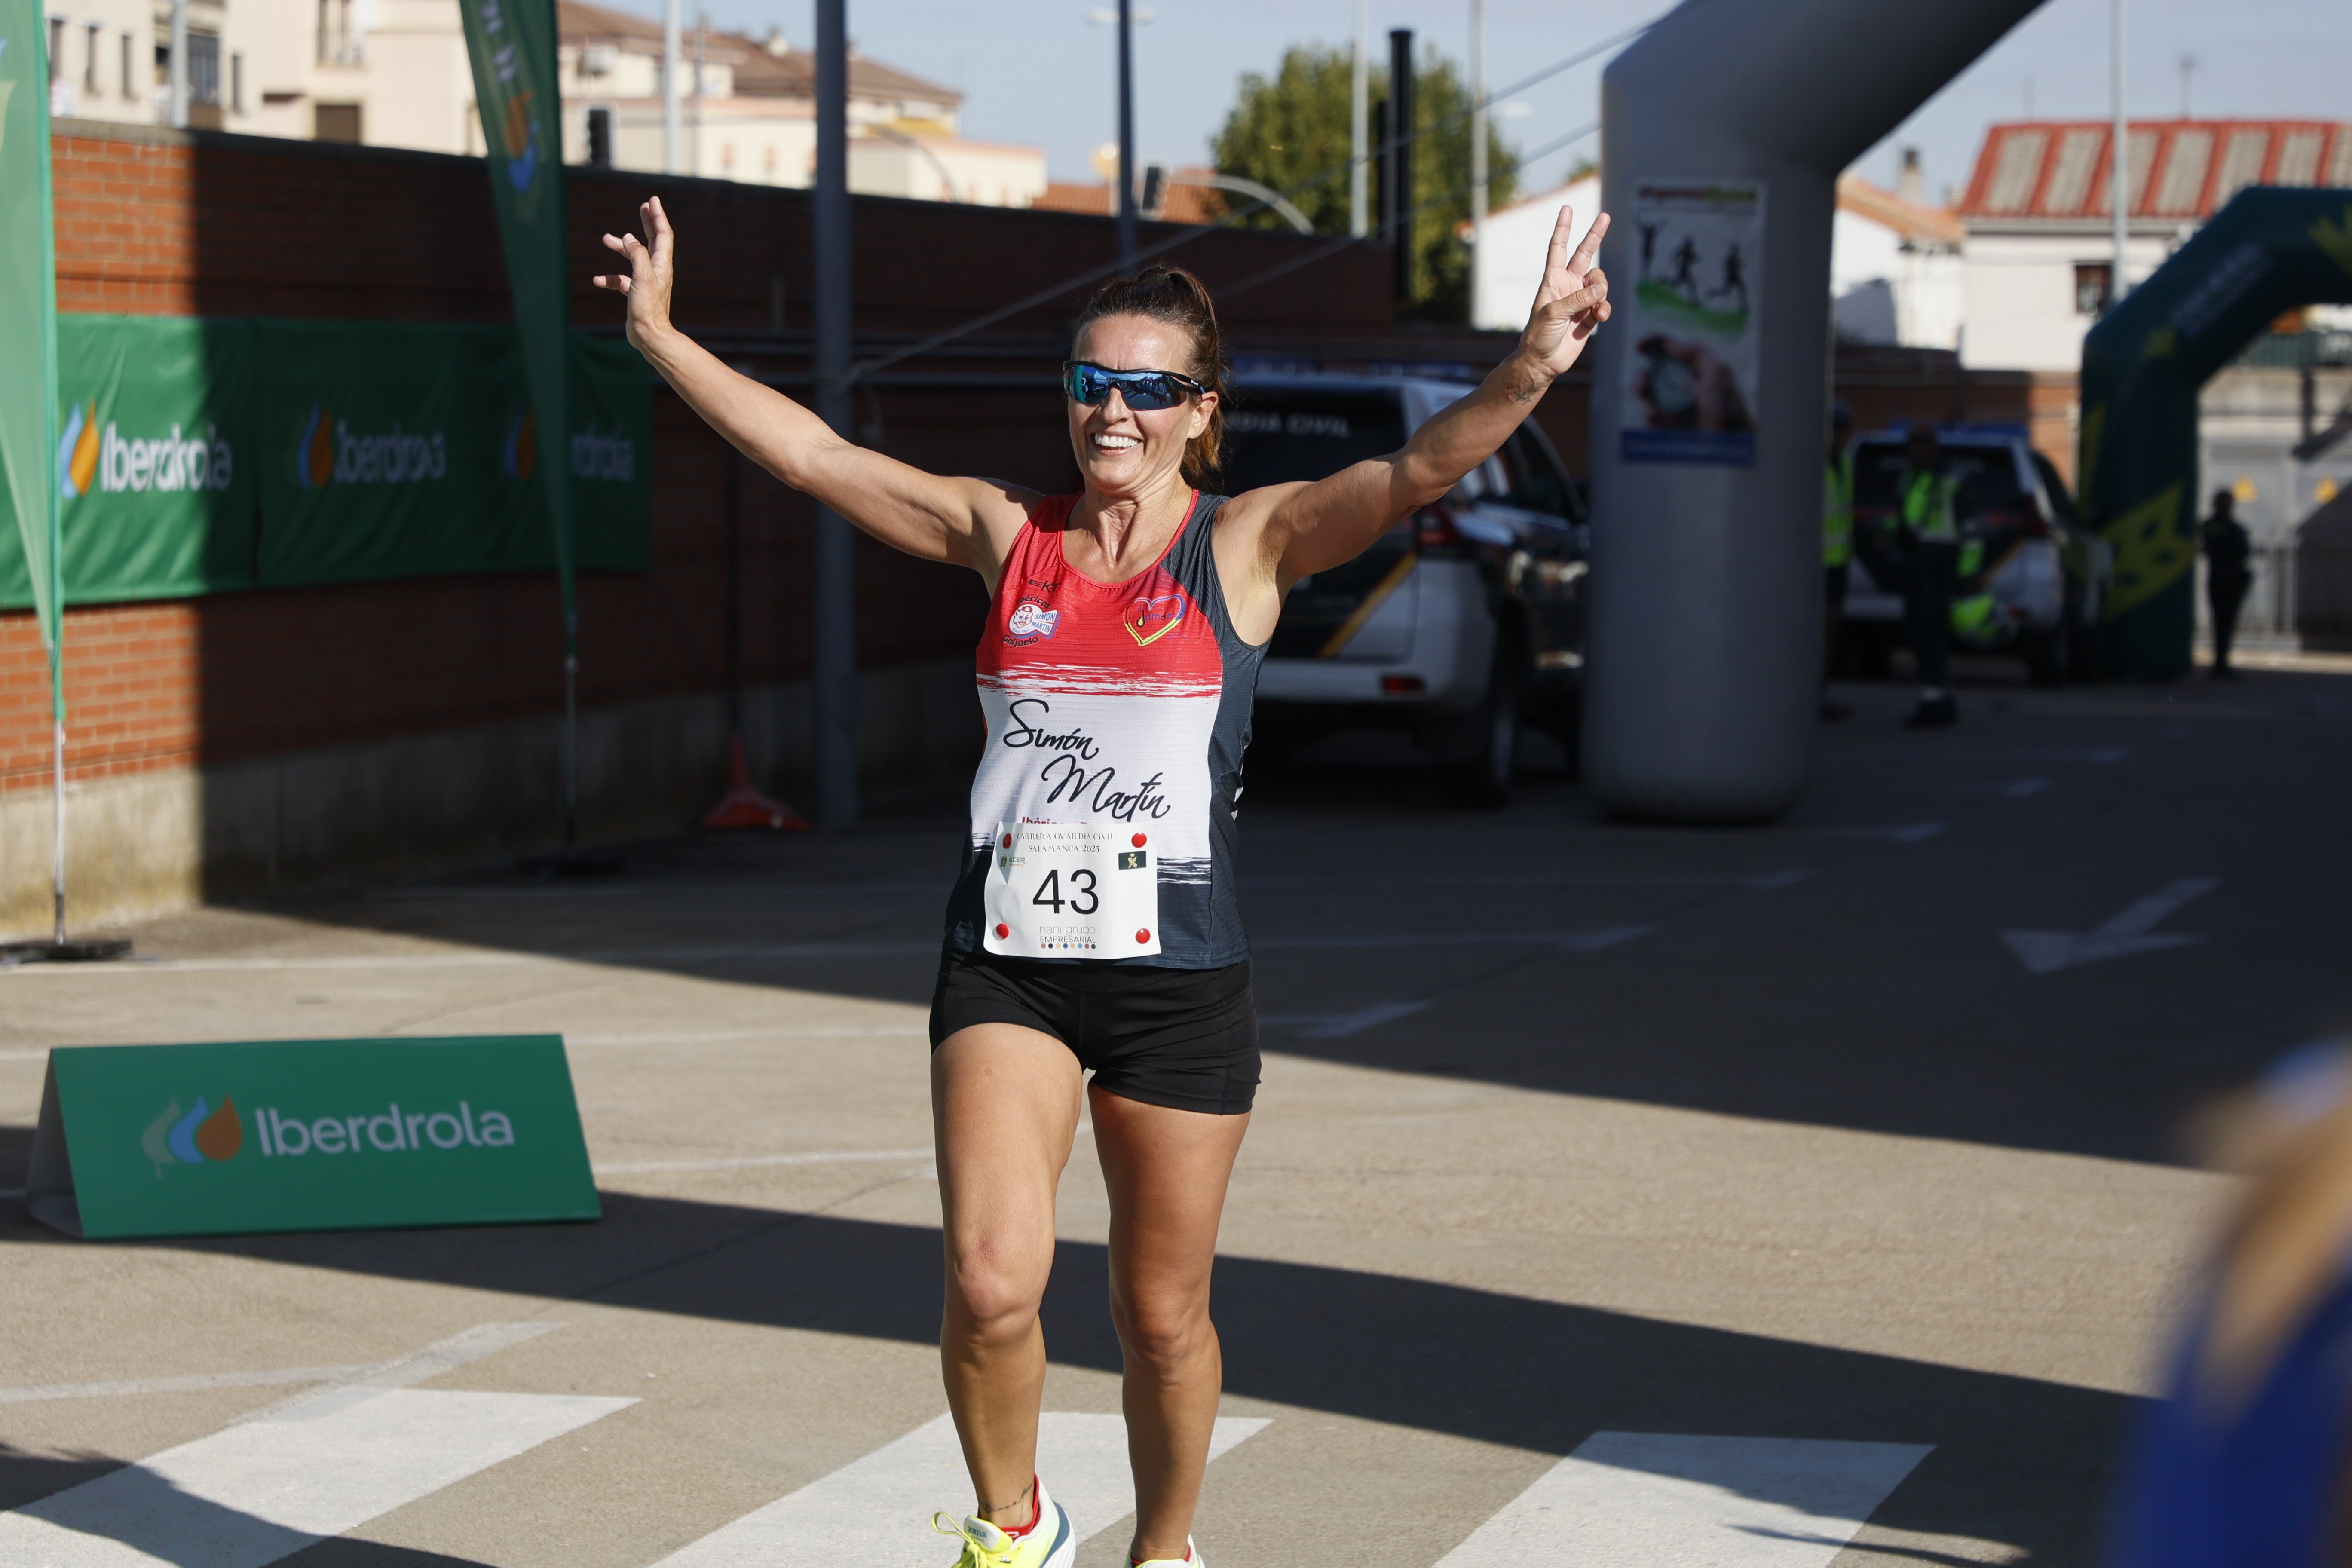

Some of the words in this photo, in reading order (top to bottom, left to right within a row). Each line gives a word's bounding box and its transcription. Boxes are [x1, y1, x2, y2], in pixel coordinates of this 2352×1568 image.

[101, 420, 233, 493] Iberdrola
[571, 420, 635, 482] rdrola
[1002, 634, 1039, 648] Guijuelo
[1032, 622, 1052, 633] MARTIN
[1035, 612, 1056, 622] SIMON
[1003, 699, 1099, 760] Simón
[1042, 755, 1171, 821] Martín
[1032, 869, 1099, 914] 43
[1039, 924, 1062, 934] nani
[1066, 926, 1096, 936] grupo
[255, 1101, 515, 1157] Iberdrola
